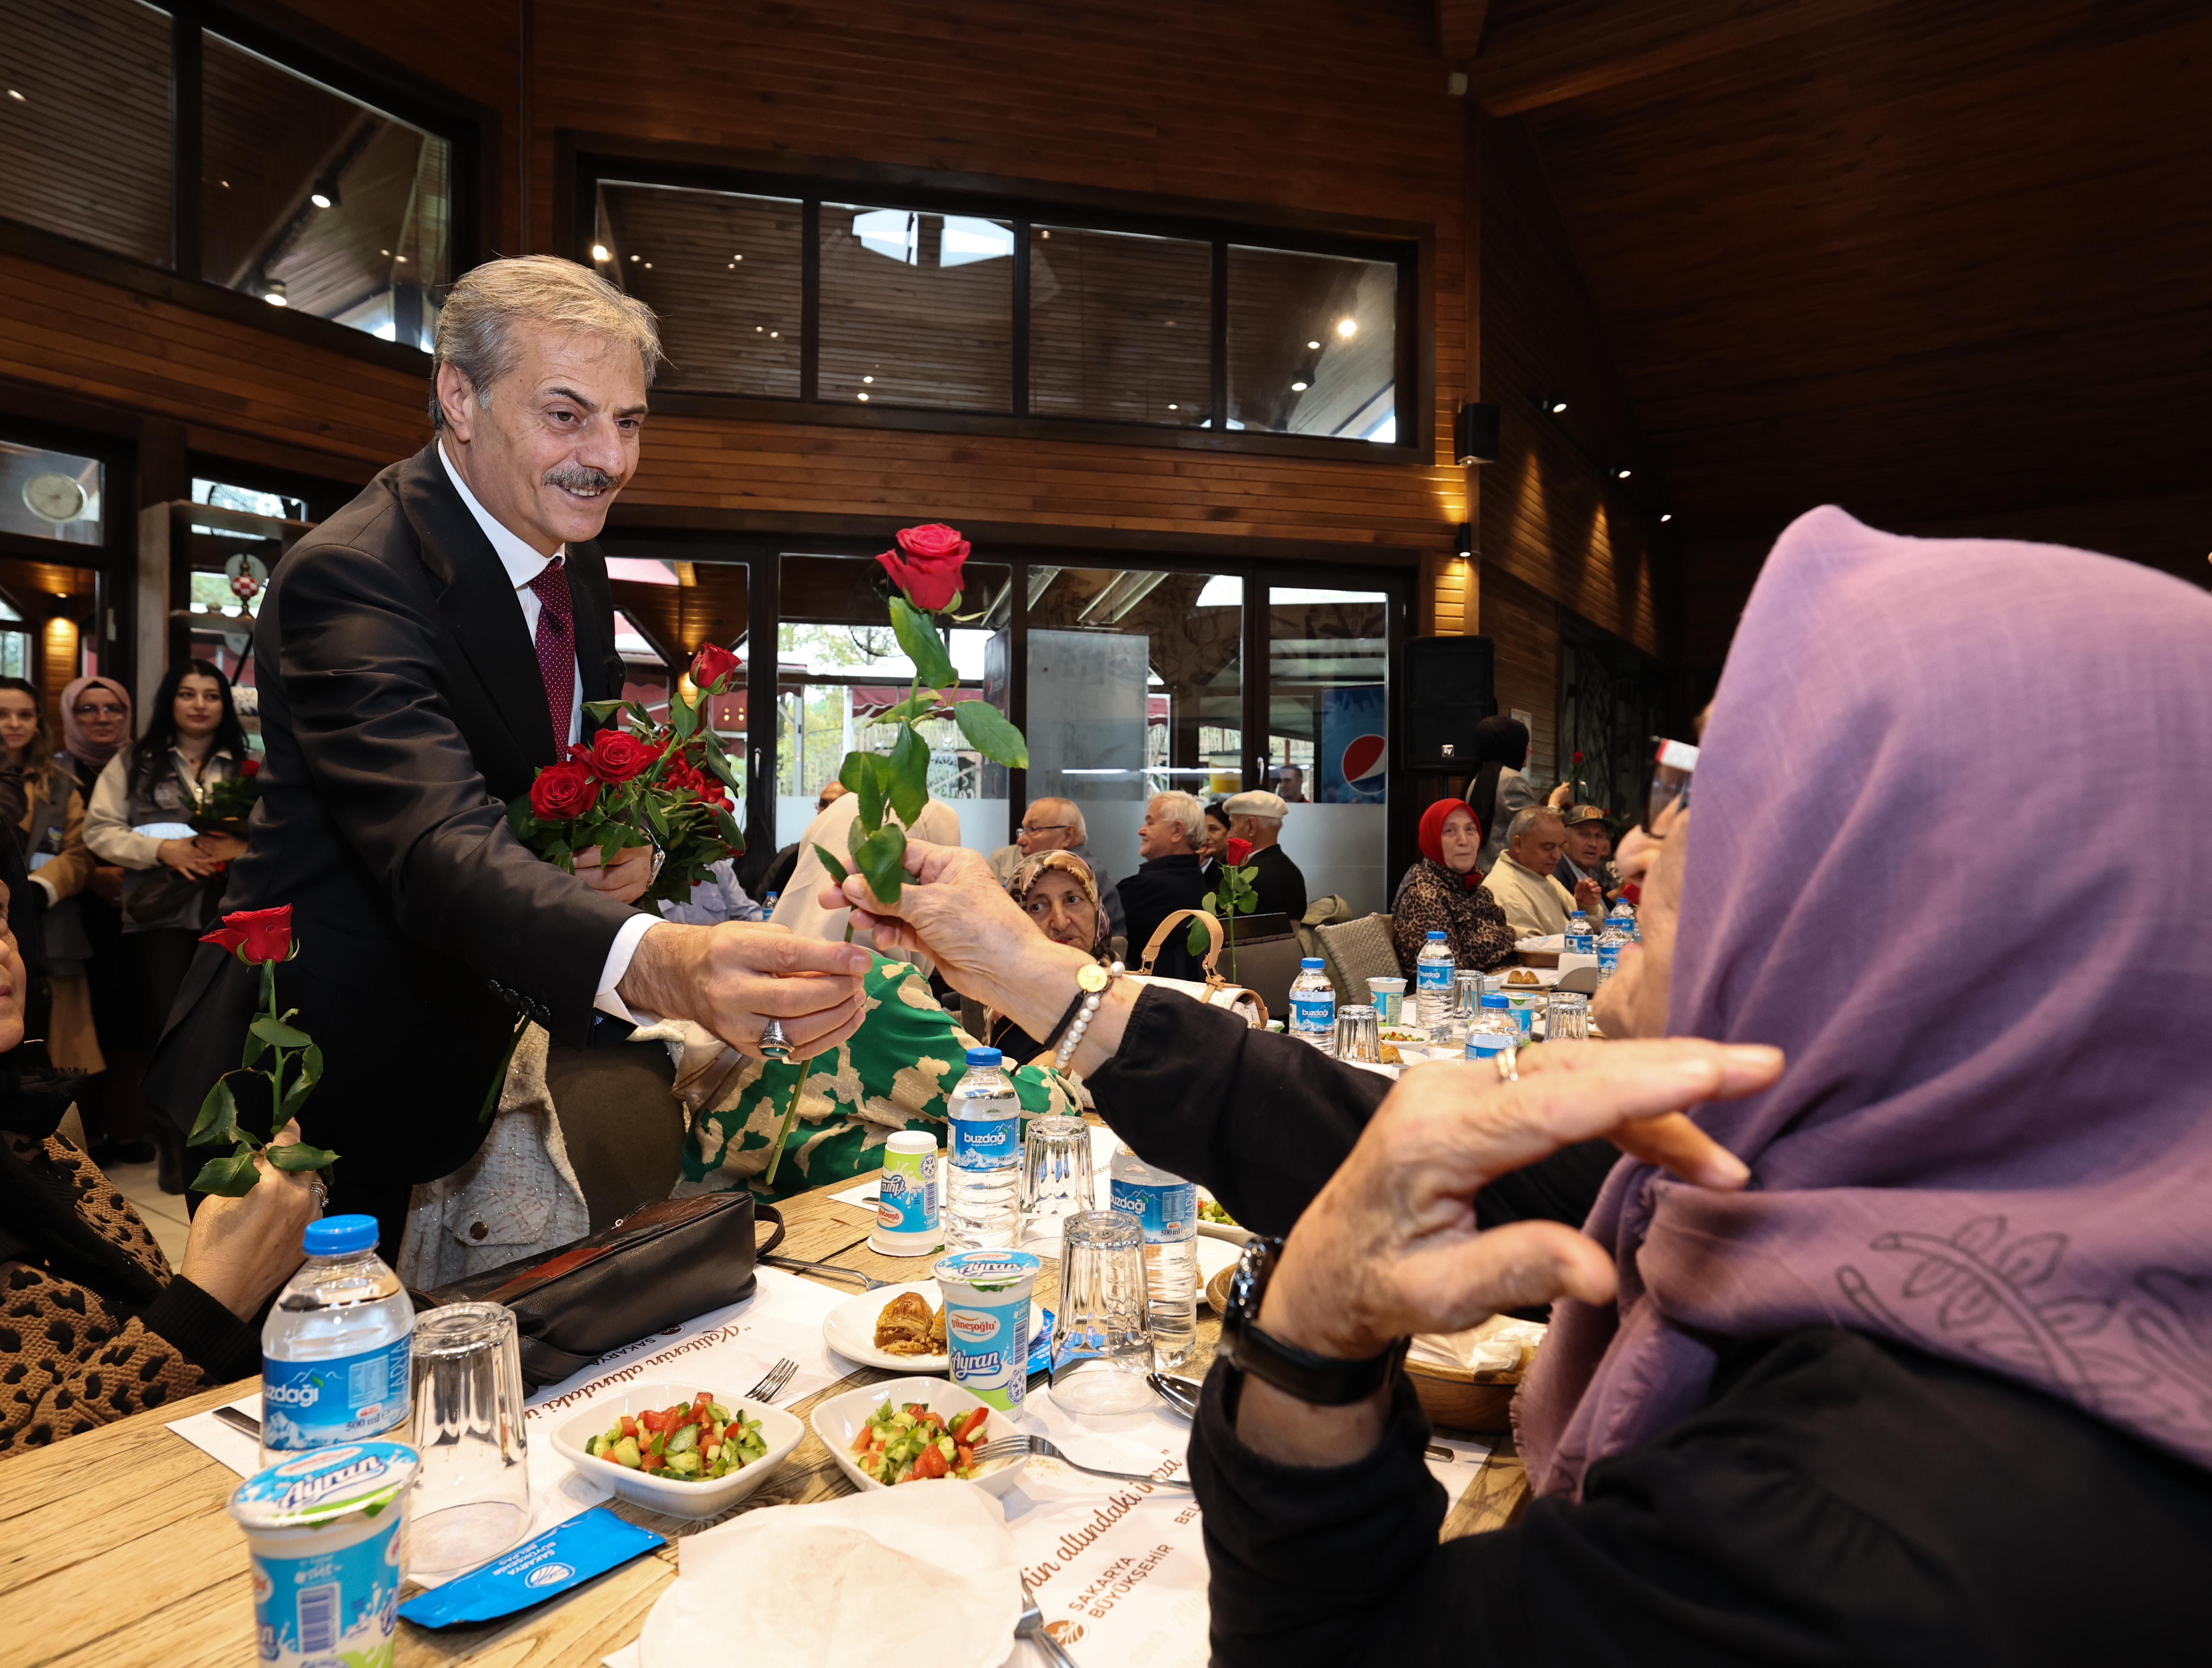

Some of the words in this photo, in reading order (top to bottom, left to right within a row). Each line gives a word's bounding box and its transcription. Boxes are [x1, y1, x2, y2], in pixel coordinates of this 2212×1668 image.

[1302, 1009, 1328, 1017] buzdağı
[964, 1132, 1006, 1145] buzdağı
[958, 1263, 1020, 1276] Ayran
[951, 1319, 995, 1333] güneşoğlu
[590, 1338, 656, 1366] SAKARYA
[951, 1351, 1001, 1379] Ayran
[346, 1417, 366, 1432] 500
[367, 1413, 380, 1426] ml
[277, 1455, 384, 1509] Ayran
[1068, 1557, 1136, 1611] SAKARYA
[1087, 1544, 1174, 1619] BÜYÜKŞEHİR
